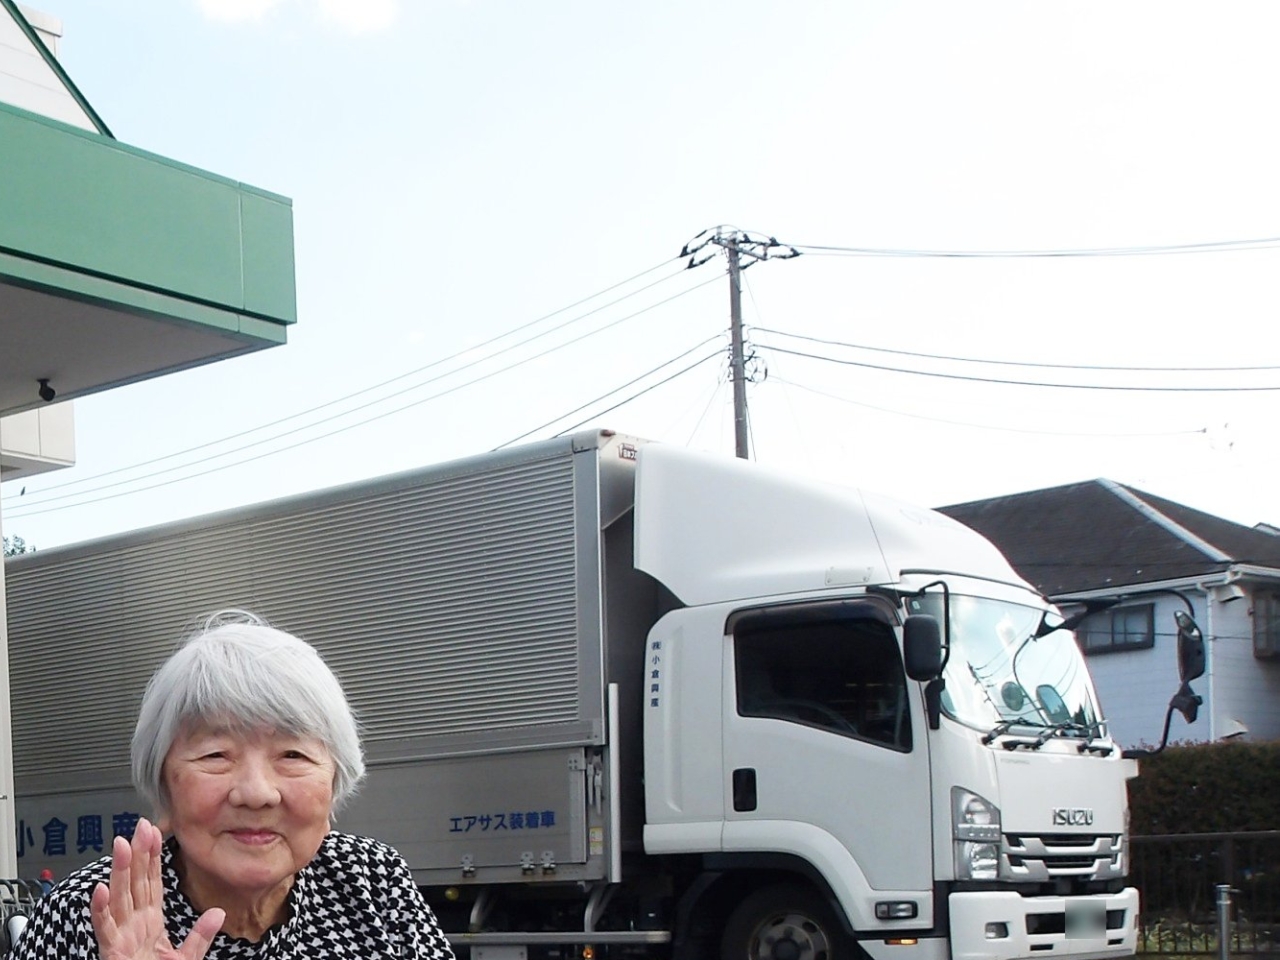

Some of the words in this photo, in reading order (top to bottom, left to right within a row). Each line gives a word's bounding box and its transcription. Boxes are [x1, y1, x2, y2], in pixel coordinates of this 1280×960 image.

[449, 810, 556, 833] エアサス装着車
[1052, 808, 1093, 826] ISUZU
